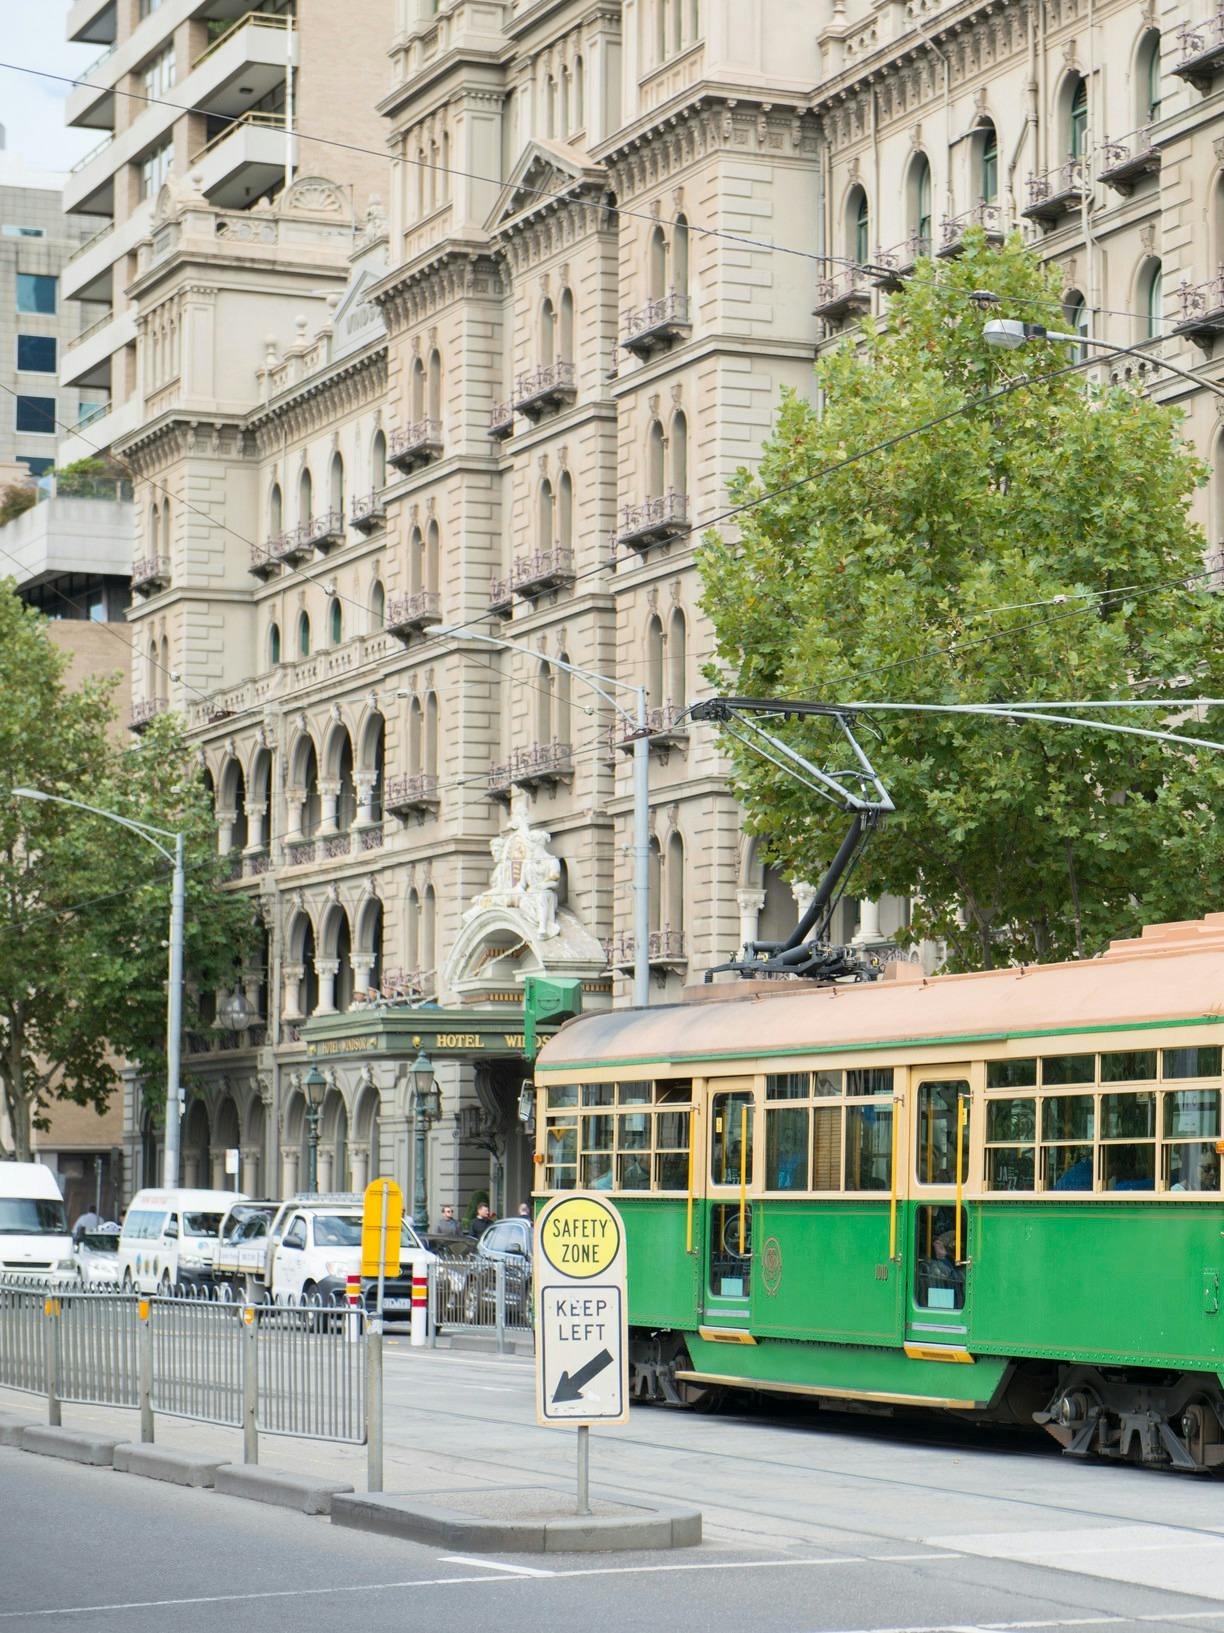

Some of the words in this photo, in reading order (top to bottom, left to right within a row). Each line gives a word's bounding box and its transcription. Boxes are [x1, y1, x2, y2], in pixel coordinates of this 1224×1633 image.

[437, 1034, 484, 1048] HOTEL
[553, 1218, 608, 1238] SAFETY
[562, 1244, 600, 1263] ZONE
[556, 1300, 607, 1317] KEEP
[559, 1324, 606, 1341] LEFT
